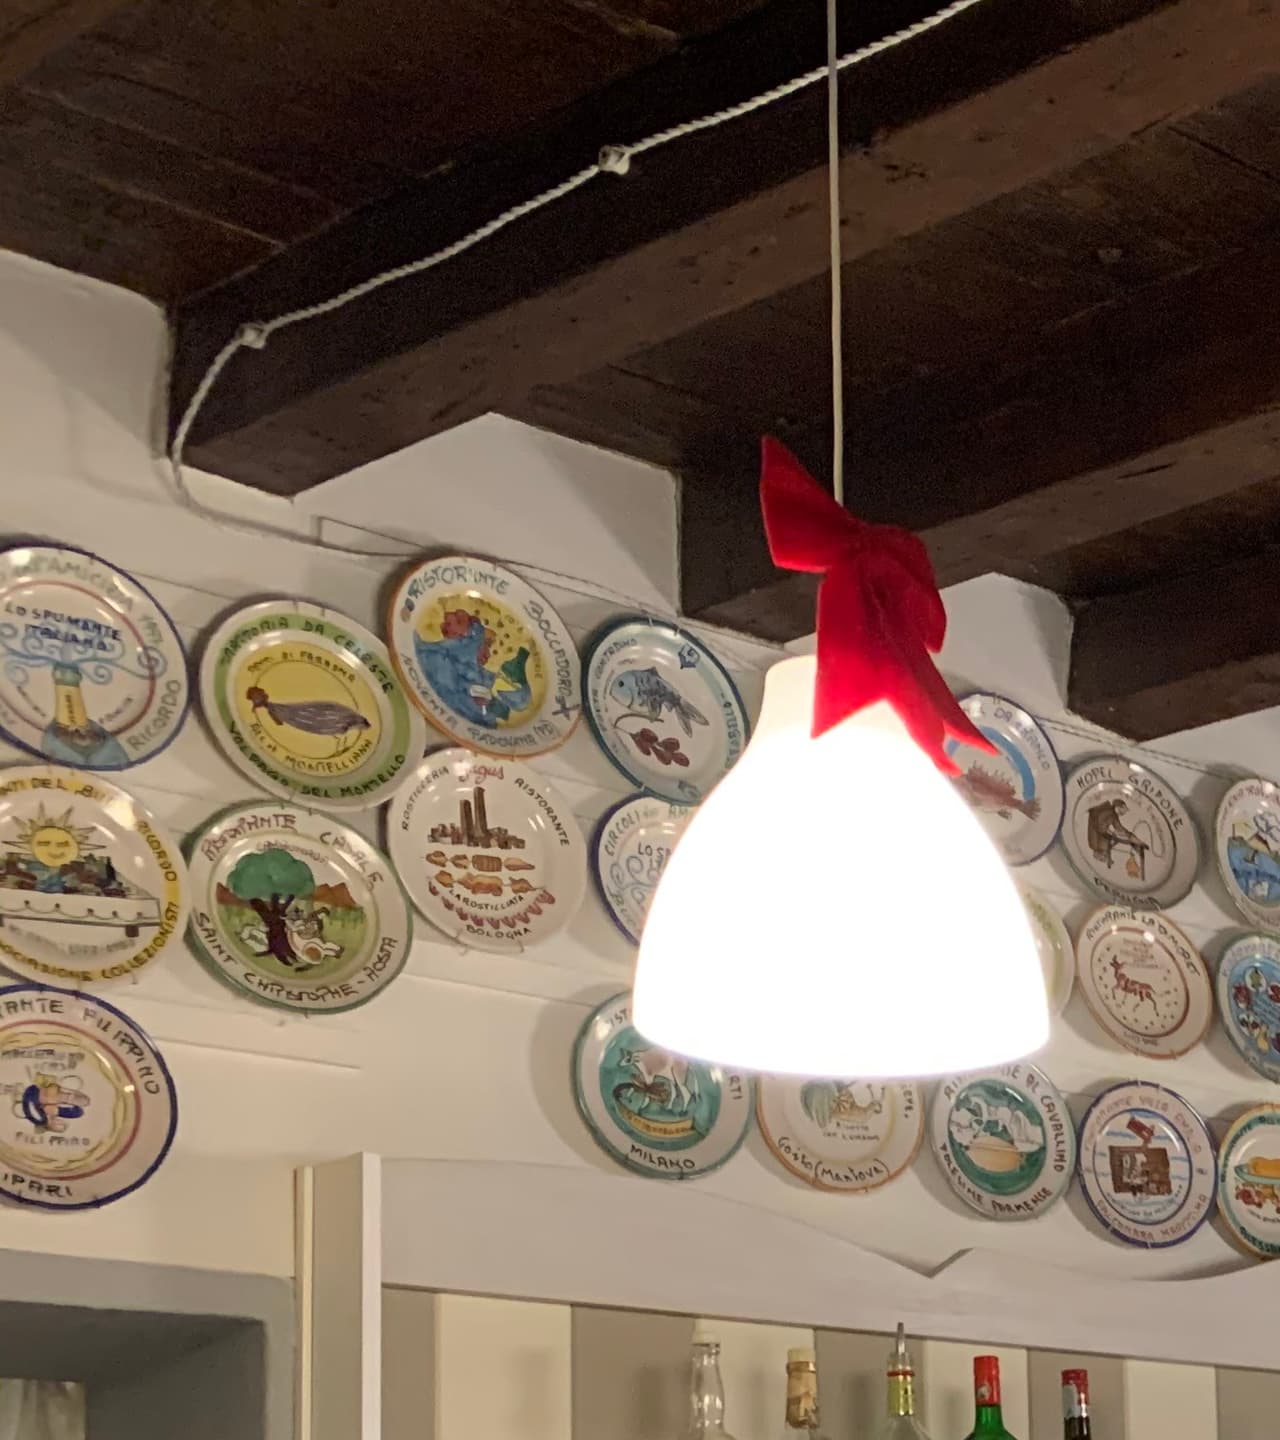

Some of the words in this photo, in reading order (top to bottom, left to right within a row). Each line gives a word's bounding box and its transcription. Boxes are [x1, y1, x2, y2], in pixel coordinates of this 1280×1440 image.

[302, 620, 325, 636] DA
[334, 634, 394, 695] CELESTE
[126, 679, 182, 751] RICORDO
[31, 778, 67, 790] DEL
[136, 820, 178, 882] RICORDO
[514, 777, 570, 847] RISTORANTE
[197, 912, 237, 964] SAINT
[465, 924, 532, 940] BOLOGNA
[83, 1007, 161, 1094] FILIPPINO
[630, 1144, 696, 1170] MILANO
